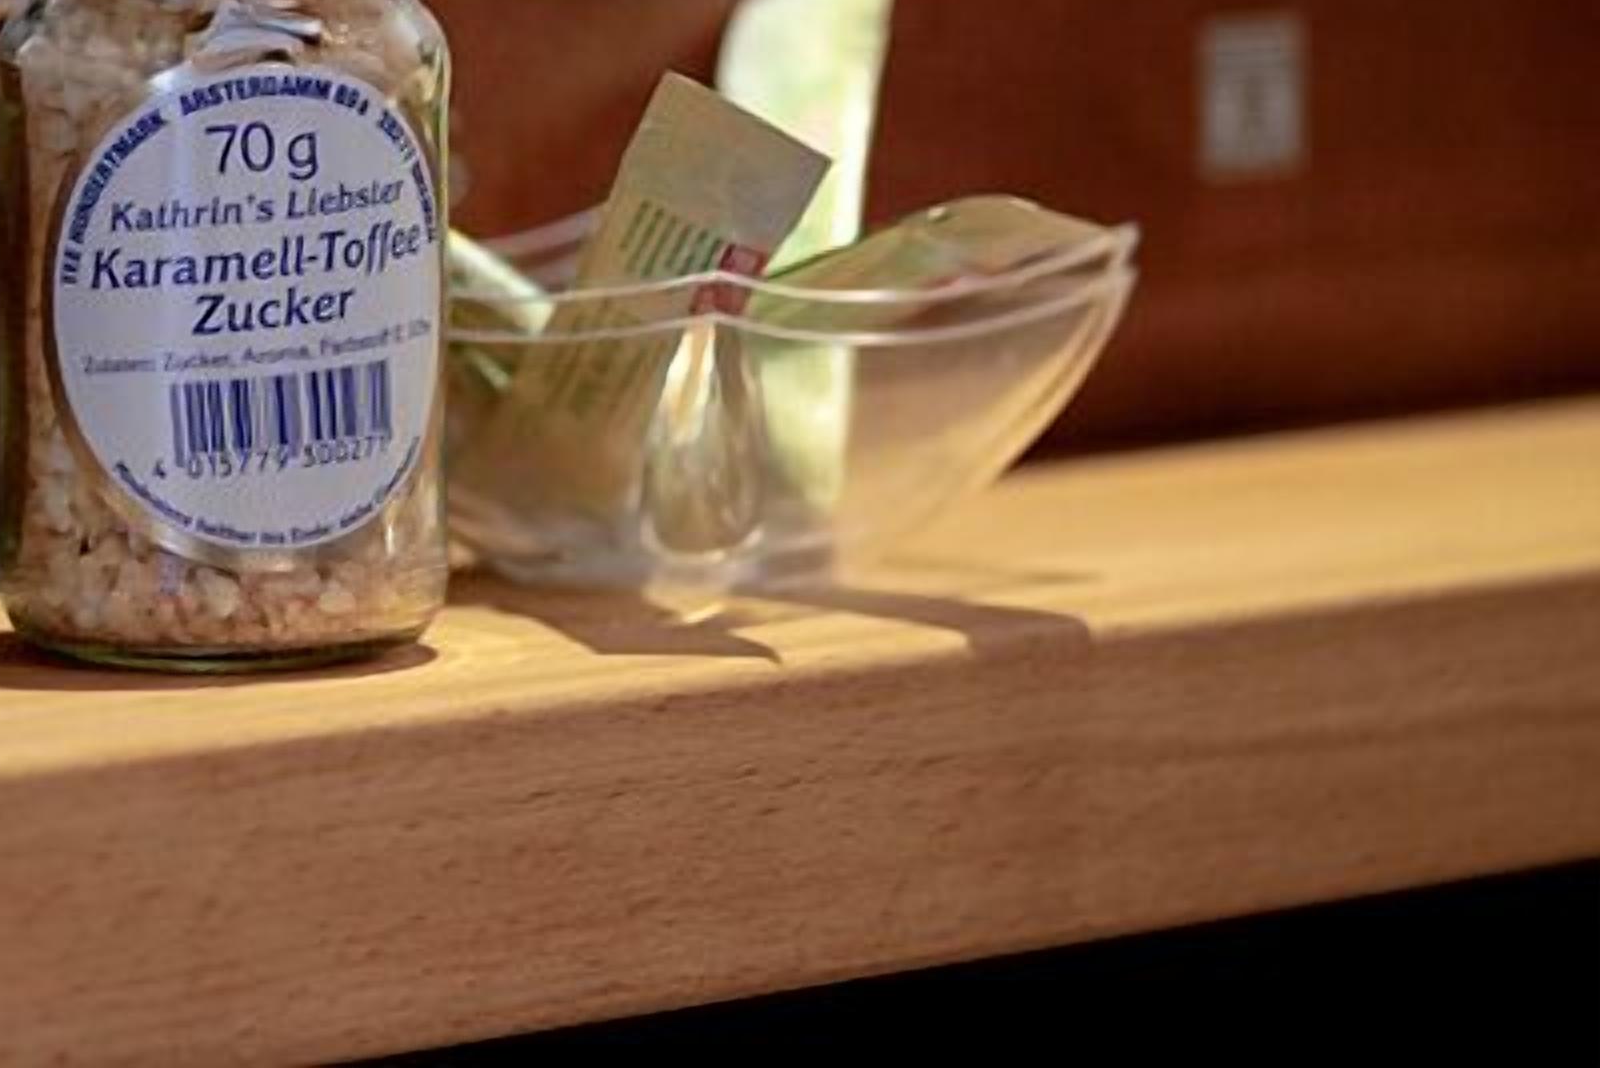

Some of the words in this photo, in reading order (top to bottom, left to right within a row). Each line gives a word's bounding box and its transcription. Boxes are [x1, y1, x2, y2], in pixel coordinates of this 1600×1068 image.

[204, 120, 276, 175] 70
[287, 131, 319, 181] g
[111, 194, 275, 232] Kathrin's
[90, 220, 422, 290] Karamell-Toffee
[192, 287, 356, 336] Zucker
